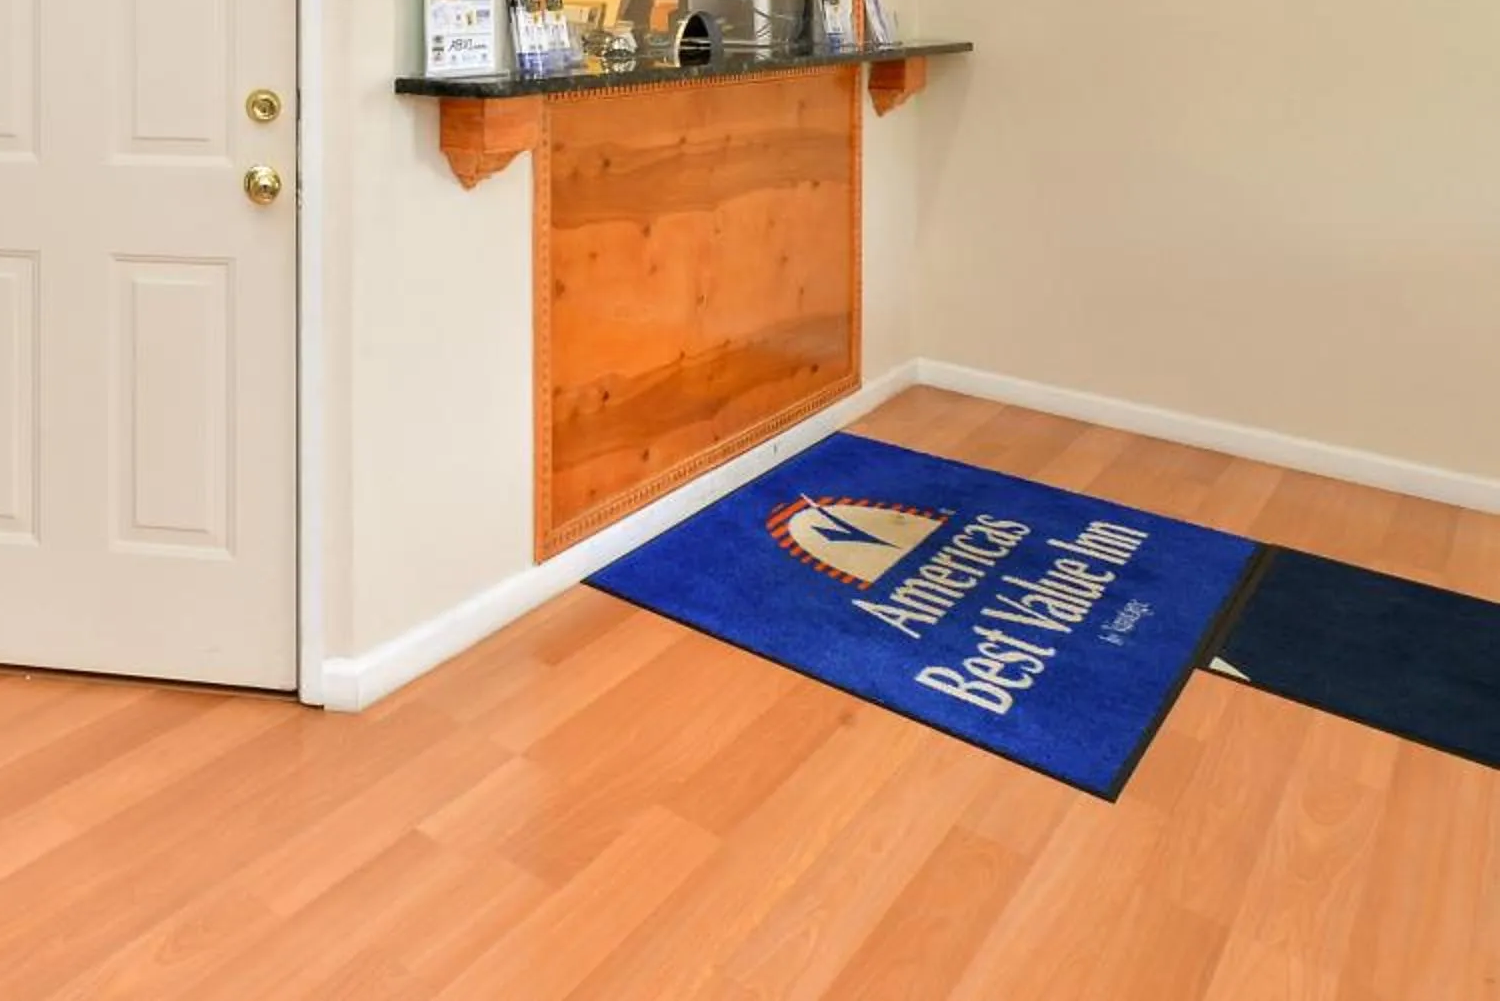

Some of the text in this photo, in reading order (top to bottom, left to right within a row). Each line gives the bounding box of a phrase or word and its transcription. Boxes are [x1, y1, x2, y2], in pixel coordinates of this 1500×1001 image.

[852, 514, 1031, 639] Americas
[914, 520, 1149, 715] Best Value Inn
